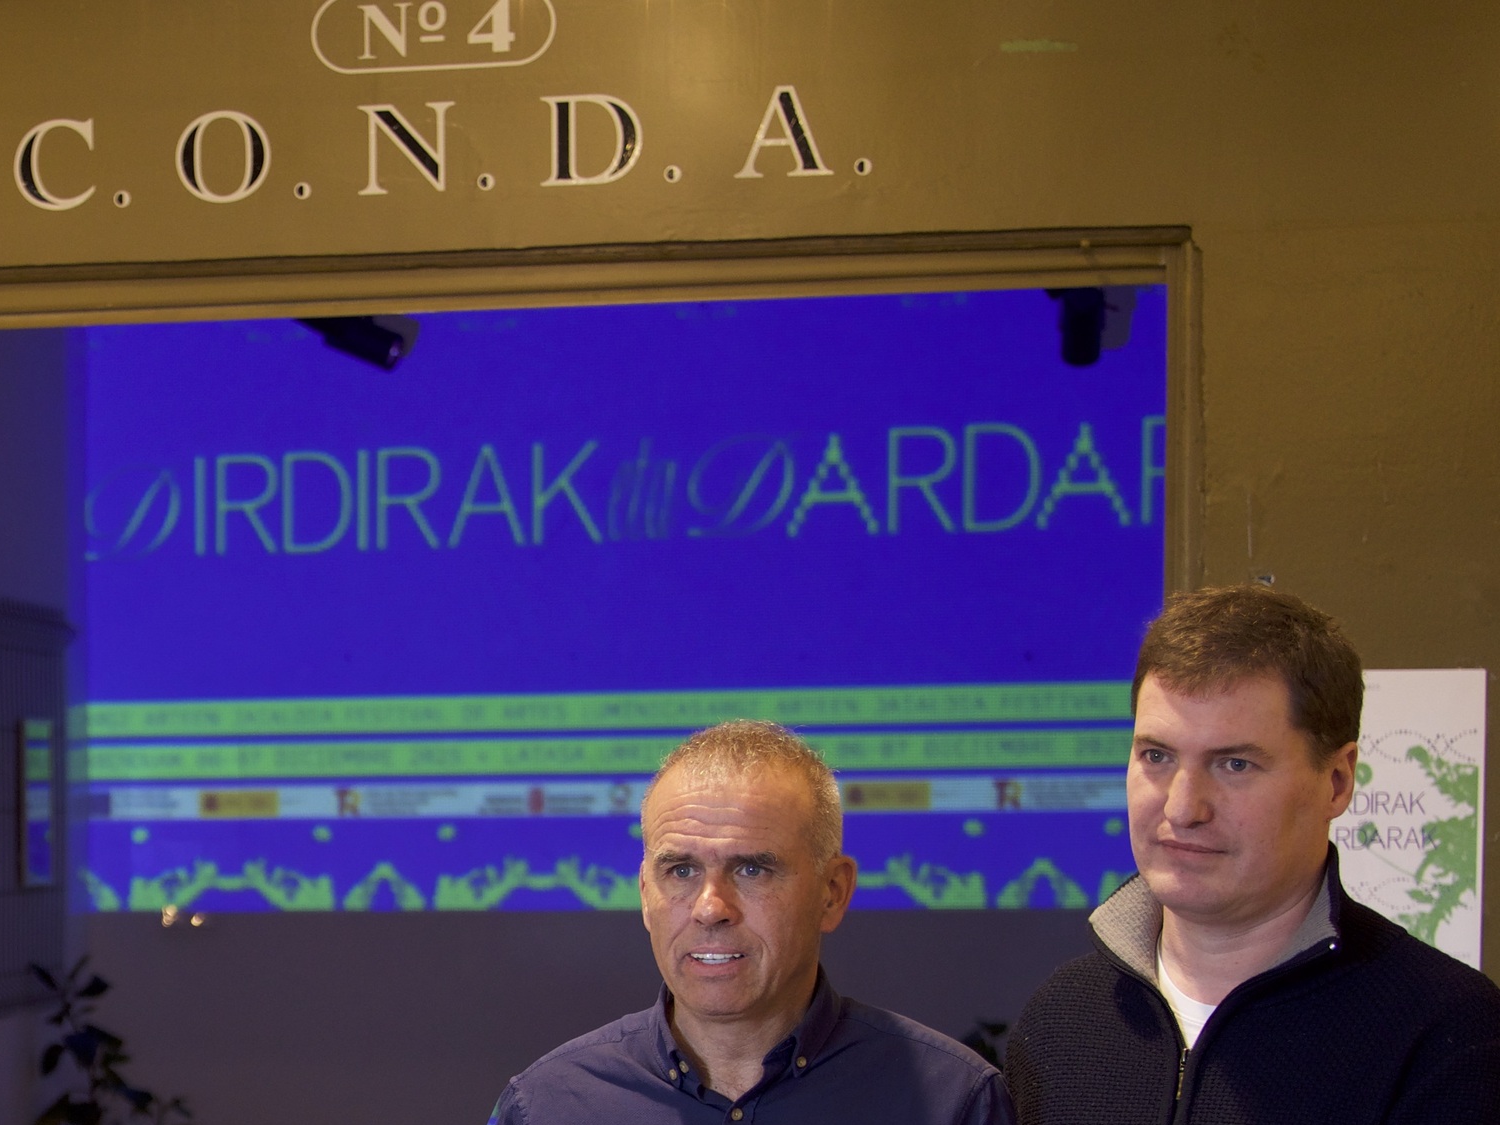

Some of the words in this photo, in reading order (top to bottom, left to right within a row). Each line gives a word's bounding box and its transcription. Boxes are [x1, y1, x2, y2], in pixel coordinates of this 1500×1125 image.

[467, 0, 515, 52] 4
[83, 440, 603, 562] DIRDIRAK
[1347, 790, 1426, 815] DIRAK
[1335, 825, 1437, 851] RDARAK
